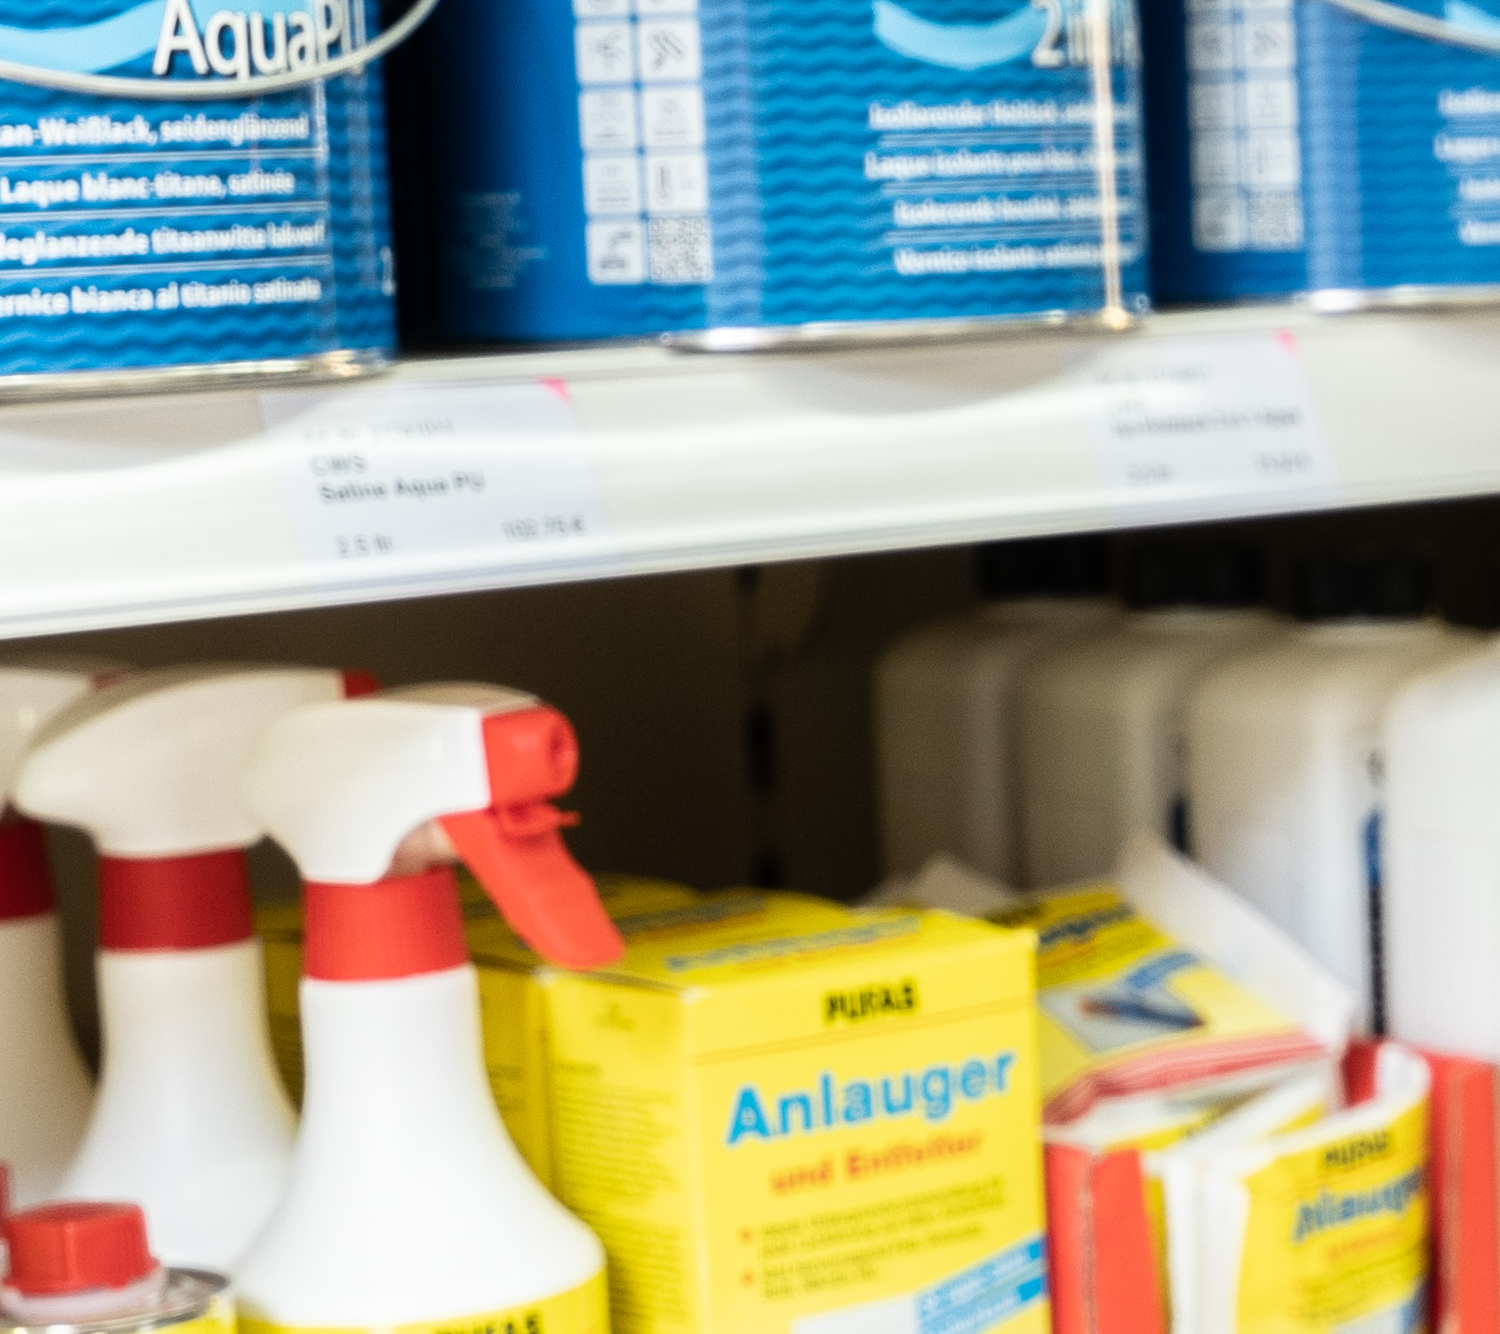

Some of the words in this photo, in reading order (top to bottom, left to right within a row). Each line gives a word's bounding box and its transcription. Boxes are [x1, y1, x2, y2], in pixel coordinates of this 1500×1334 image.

[0, 175, 80, 207] Laque
[71, 285, 153, 315] bianca
[725, 1051, 1018, 1147] Anlauger
